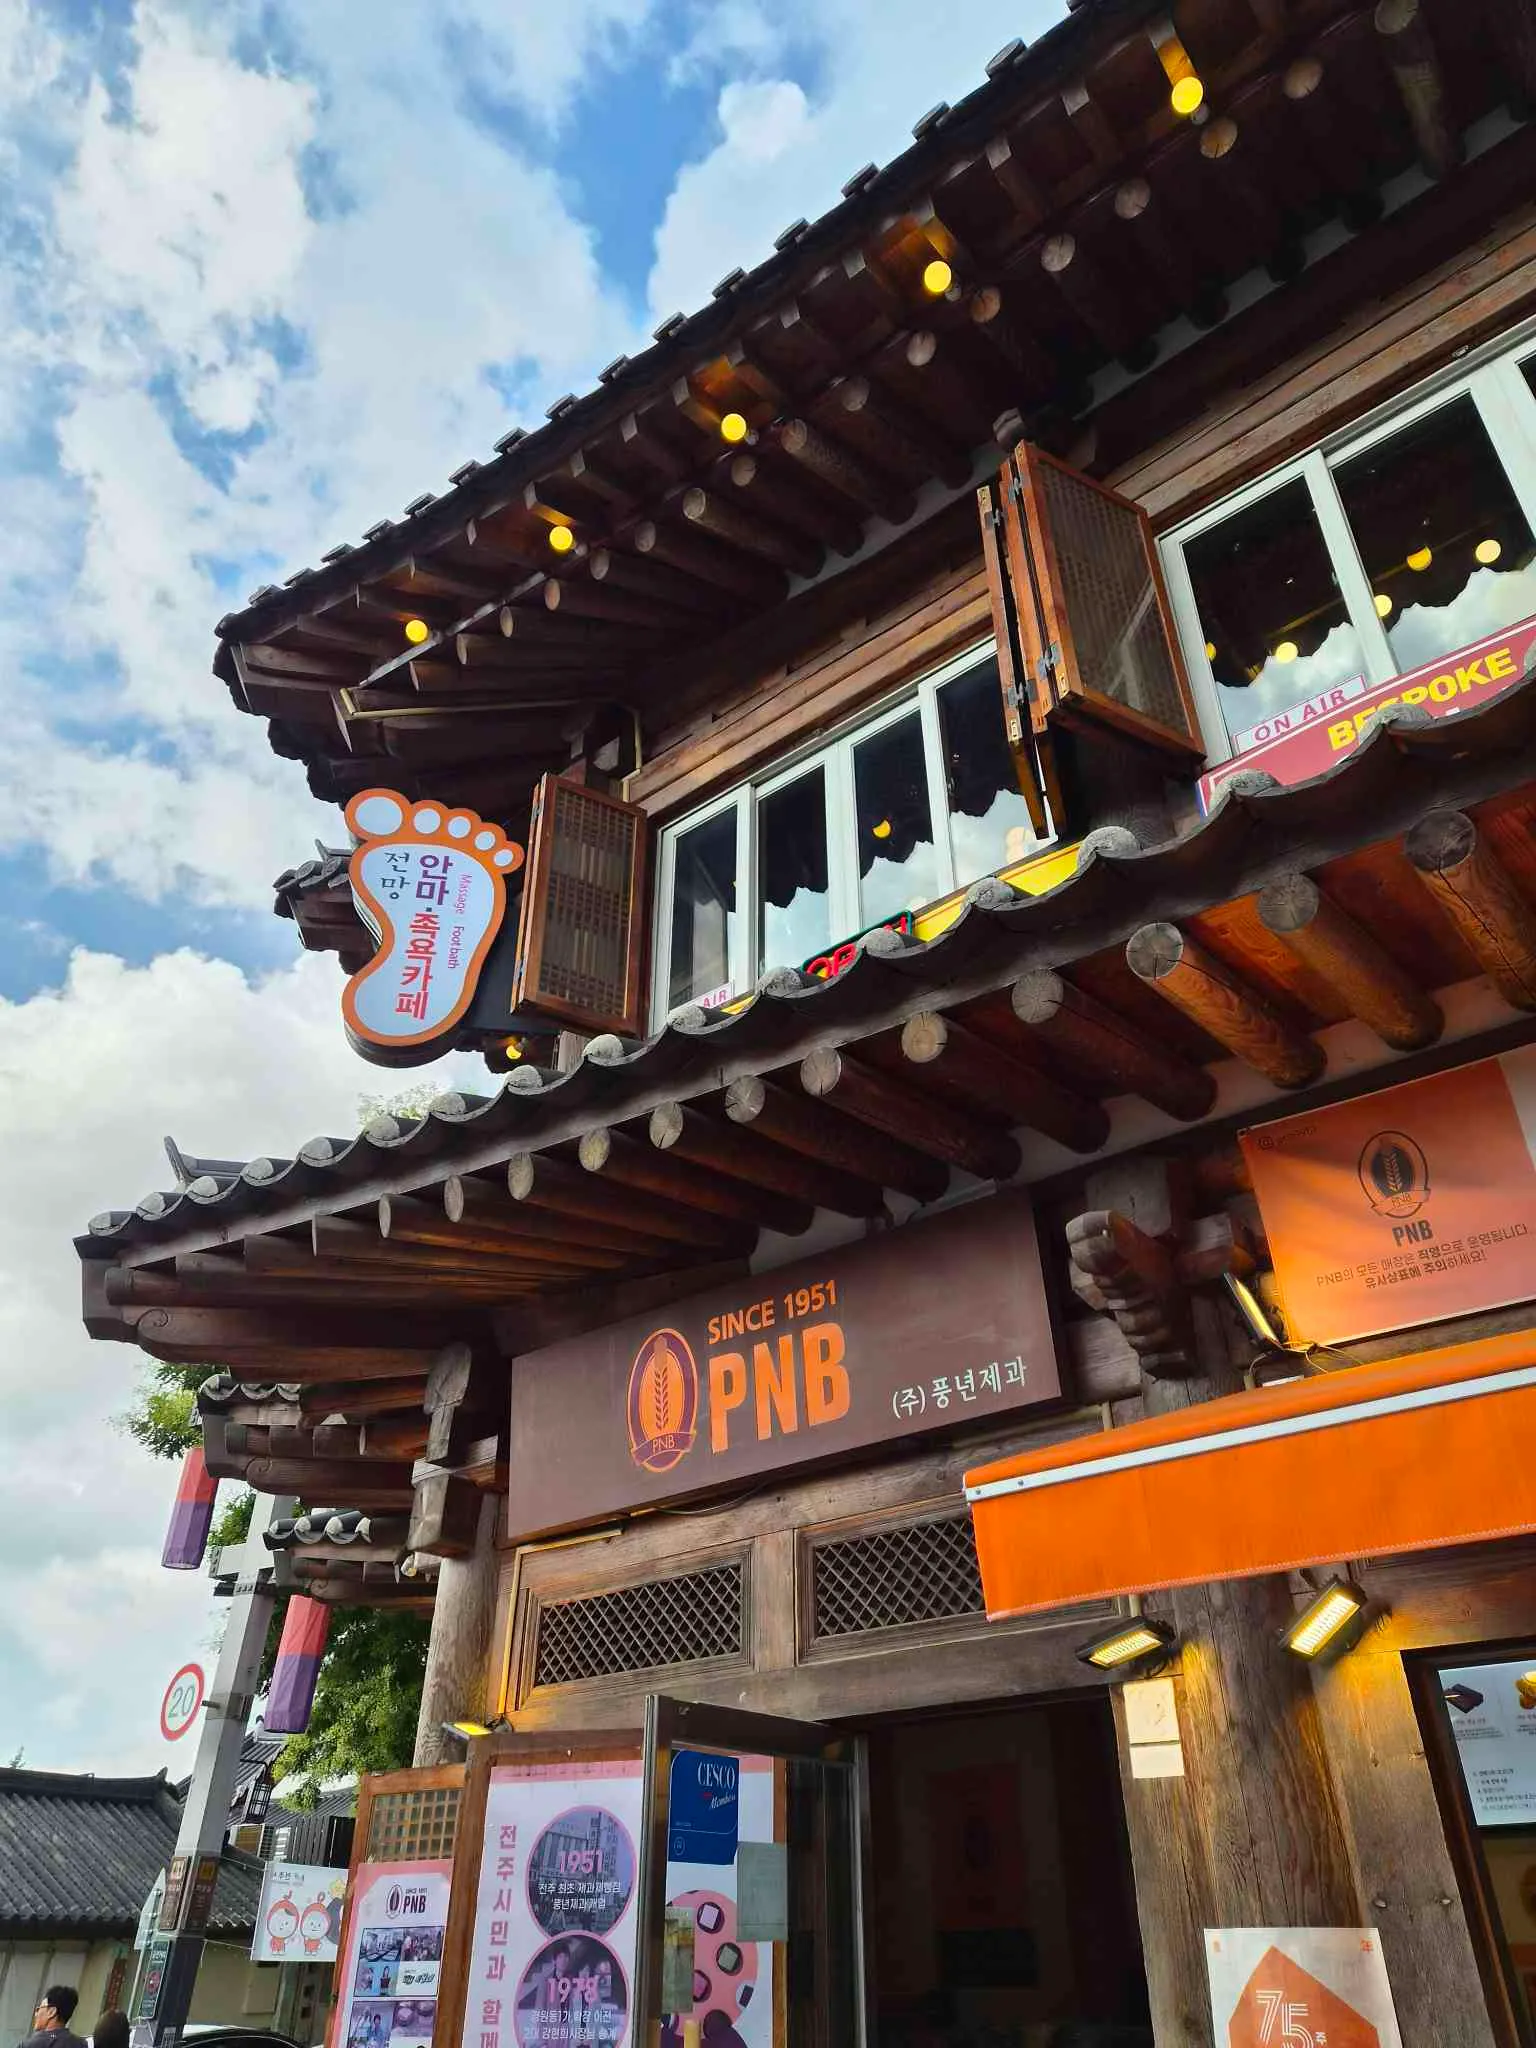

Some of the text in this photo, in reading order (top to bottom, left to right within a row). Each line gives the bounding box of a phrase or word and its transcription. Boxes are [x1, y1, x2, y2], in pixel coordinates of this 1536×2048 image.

[1253, 689, 1350, 742] ON AIR
[1327, 648, 1518, 751] BEPOKE
[381, 852, 411, 900] 전망
[448, 873, 473, 969] Massage Foot bath
[807, 915, 907, 980] OP
[703, 989, 728, 1008] AIR
[1392, 1220, 1433, 1247] PNB
[1316, 1268, 1354, 1287] PNB의
[1356, 1262, 1379, 1278] 모든
[1381, 1254, 1417, 1272] 매장은
[1418, 1241, 1465, 1260] 직영으로
[1365, 1266, 1422, 1289] 유사상표에
[707, 1279, 837, 1345] SINCE 1951
[709, 1322, 851, 1455] PNB
[652, 1434, 675, 1455] PNB
[167, 1685, 195, 1719] 20
[697, 1761, 736, 1790] CESCO
[558, 1849, 604, 1873] 1951
[402, 1895, 426, 1914] PNB
[538, 1882, 556, 1895] 전주
[1256, 1989, 1314, 2048] 75
